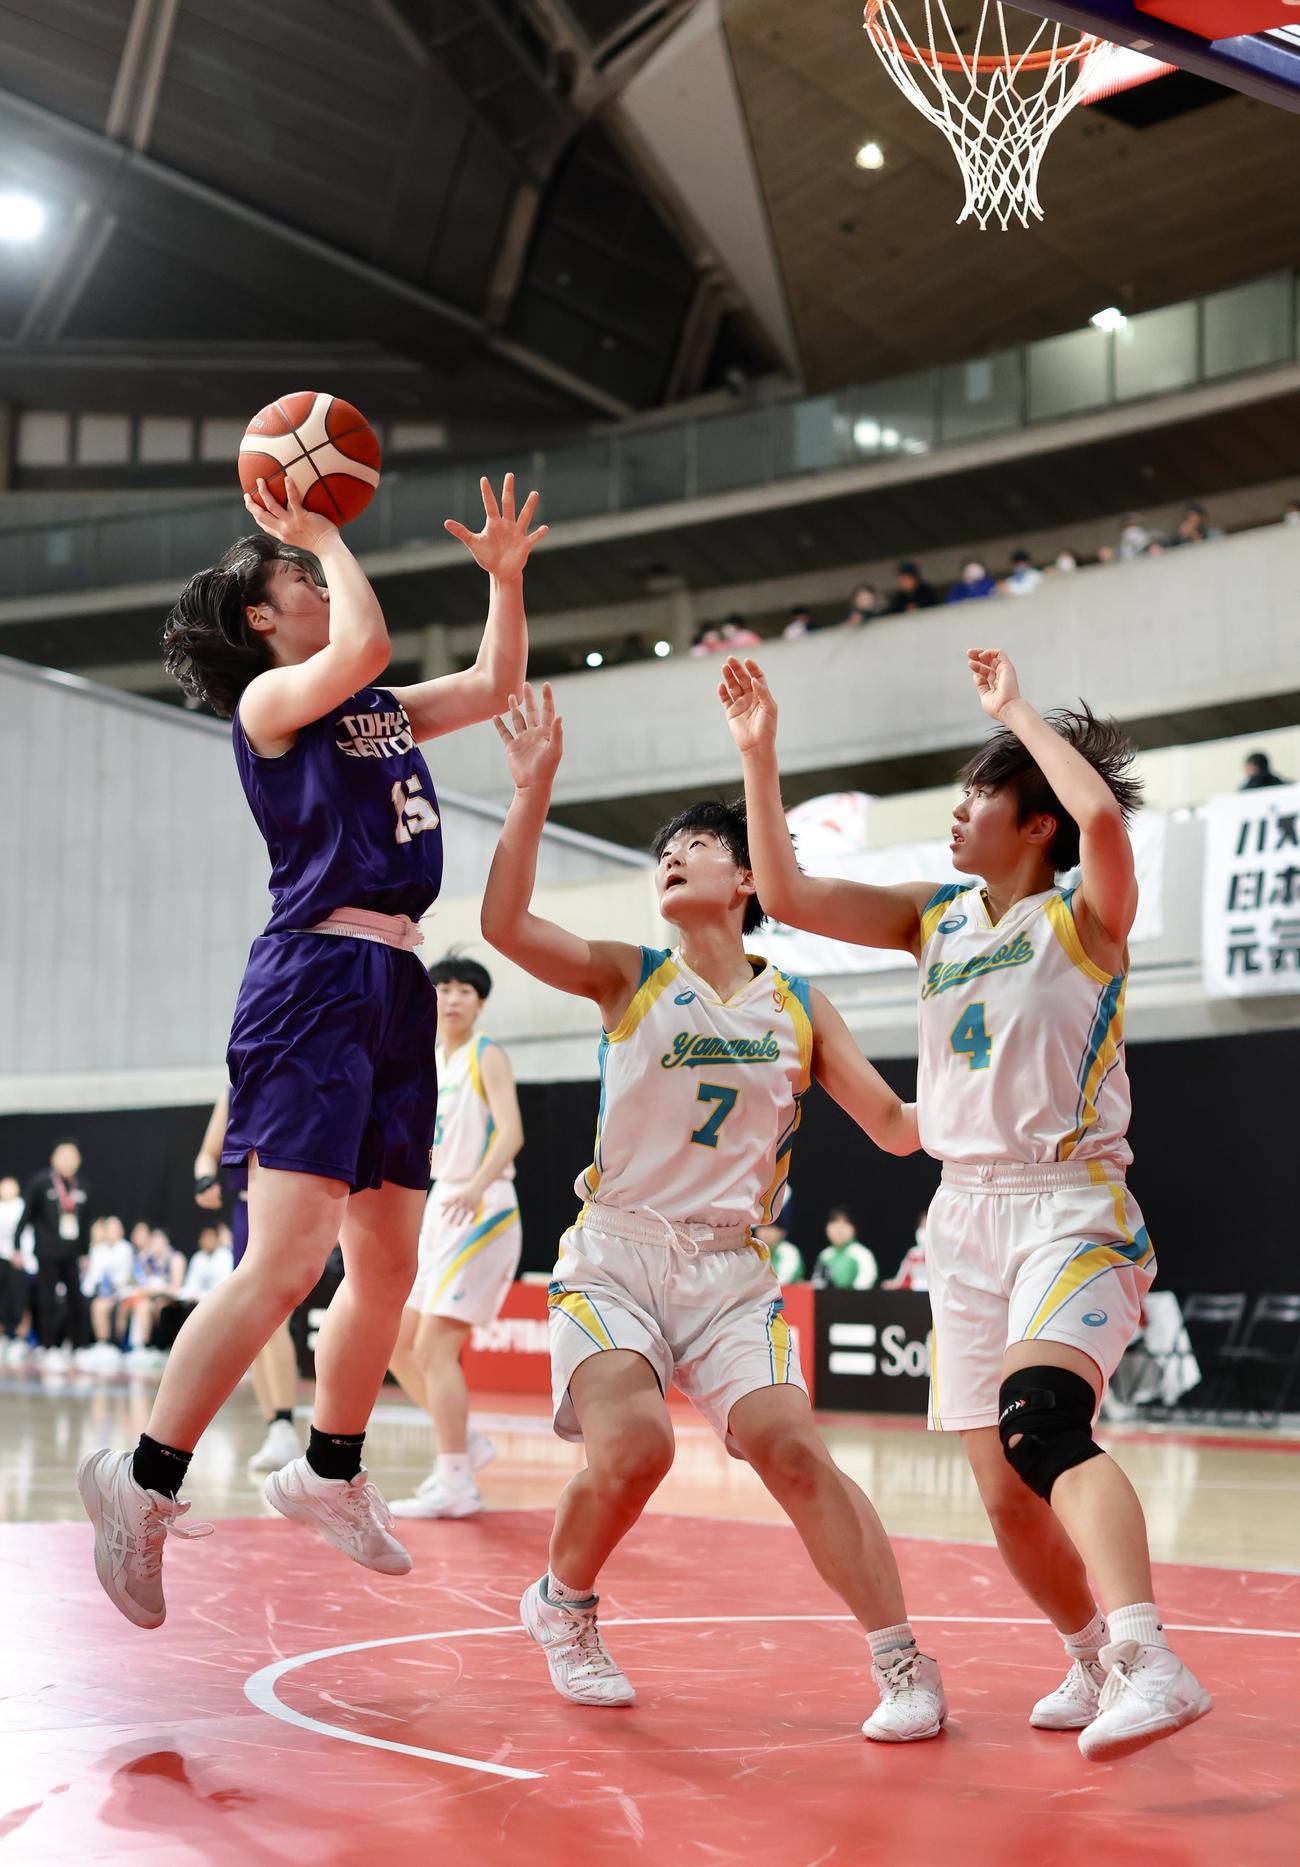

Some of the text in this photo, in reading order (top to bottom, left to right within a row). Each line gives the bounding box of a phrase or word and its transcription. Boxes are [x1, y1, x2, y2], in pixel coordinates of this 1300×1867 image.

[392, 773, 440, 844] 15
[661, 1030, 780, 1069] Yamanote
[949, 1001, 993, 1072] 4
[690, 1081, 740, 1150] 7
